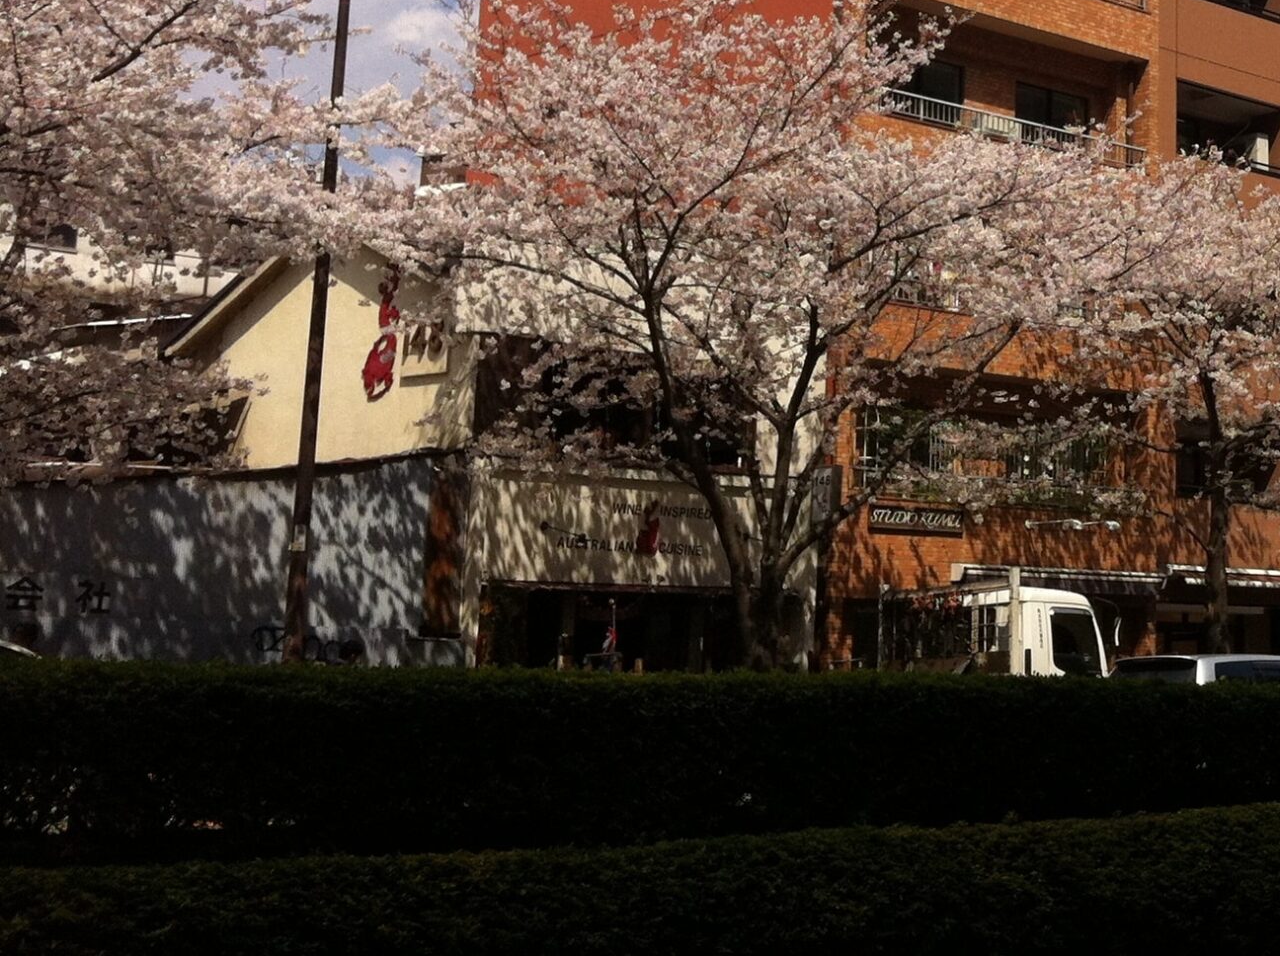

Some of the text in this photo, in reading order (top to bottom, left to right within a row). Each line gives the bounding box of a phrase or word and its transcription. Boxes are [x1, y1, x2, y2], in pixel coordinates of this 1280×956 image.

[612, 502, 712, 520] WINE INSPIRED
[870, 509, 917, 525] STUDIO
[659, 542, 703, 556] CUISINE
[5, 576, 112, 614] 会社
